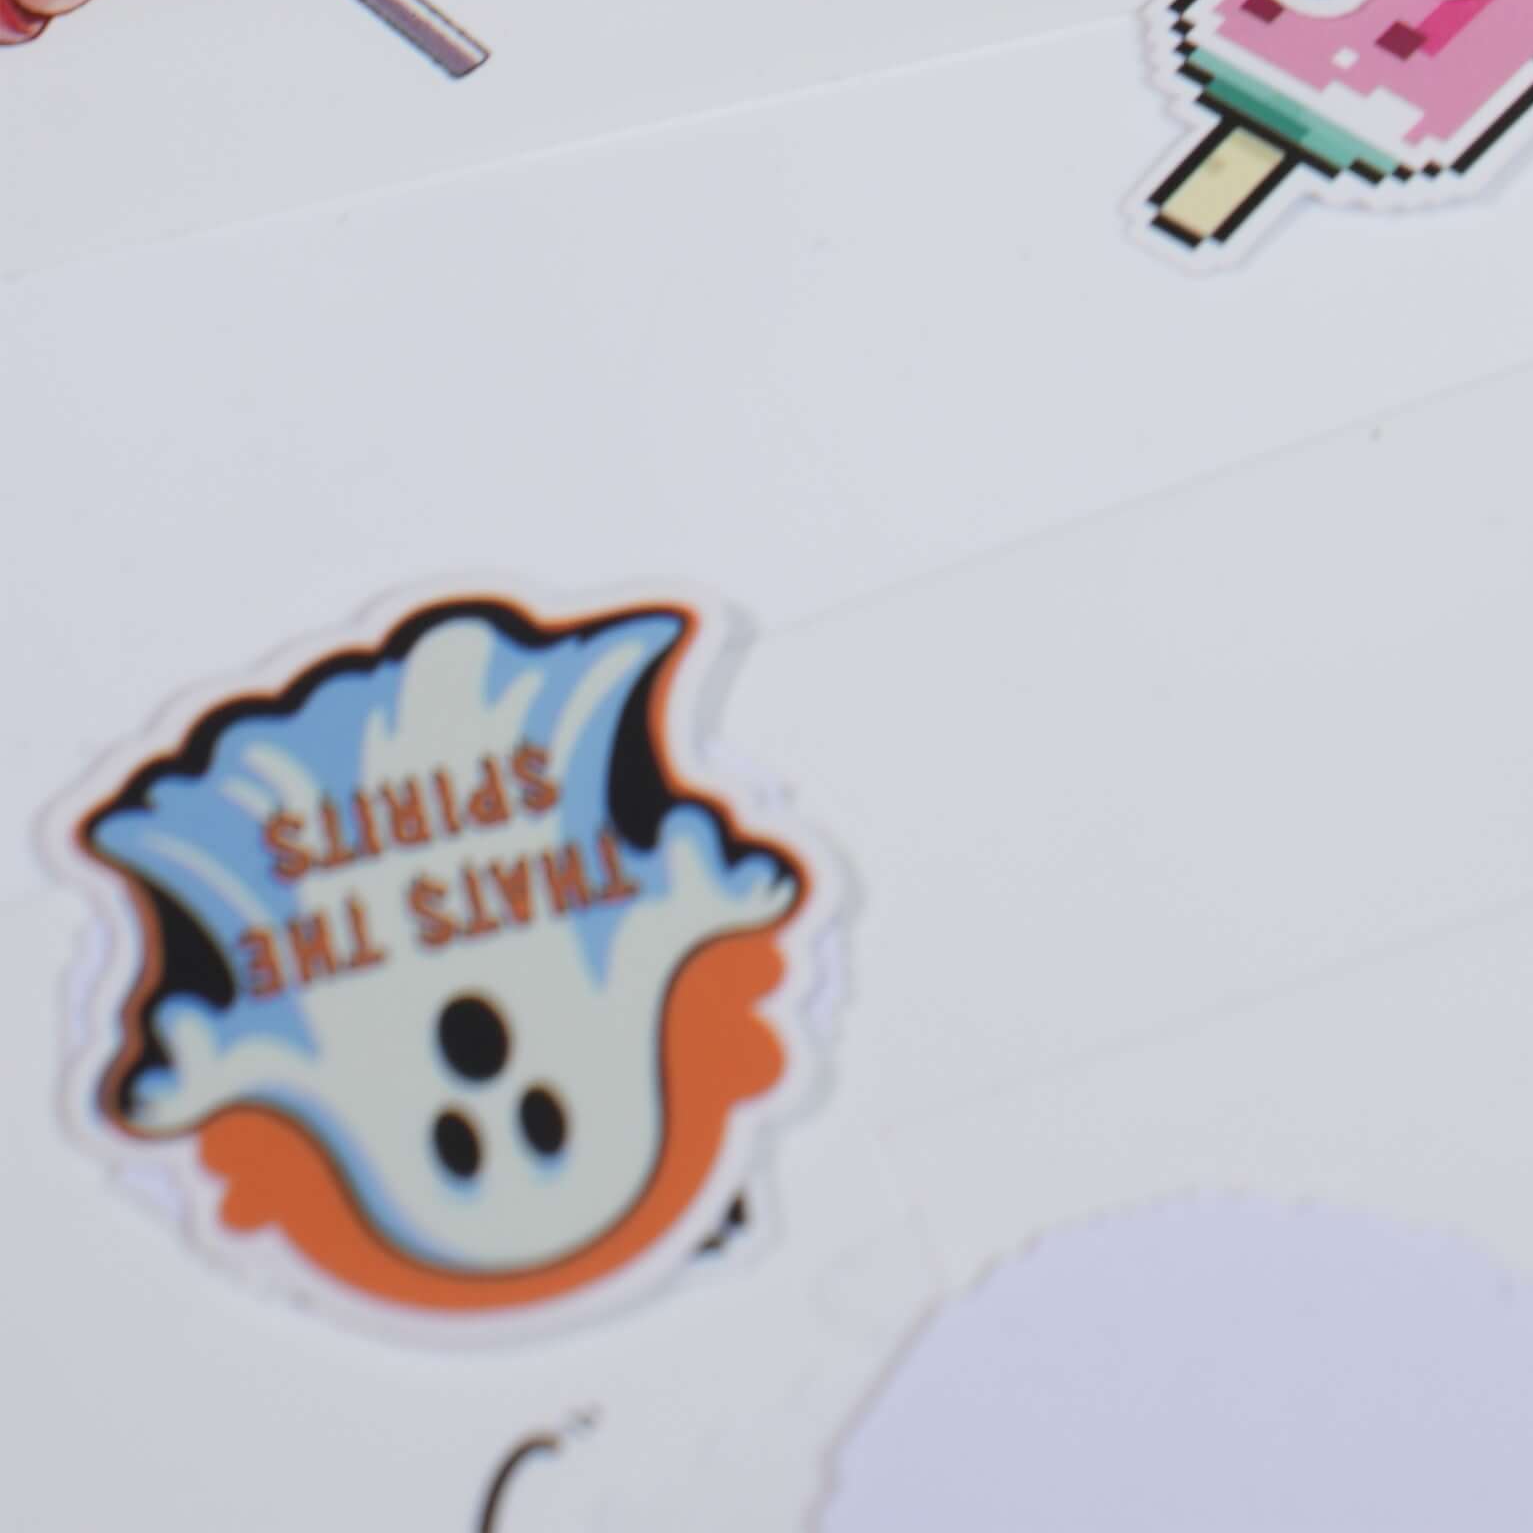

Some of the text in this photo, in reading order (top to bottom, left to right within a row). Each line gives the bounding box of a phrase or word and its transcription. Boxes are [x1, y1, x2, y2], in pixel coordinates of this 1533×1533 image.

[263, 737, 561, 887] SPIRITS
[238, 821, 641, 1001] THATS THE
